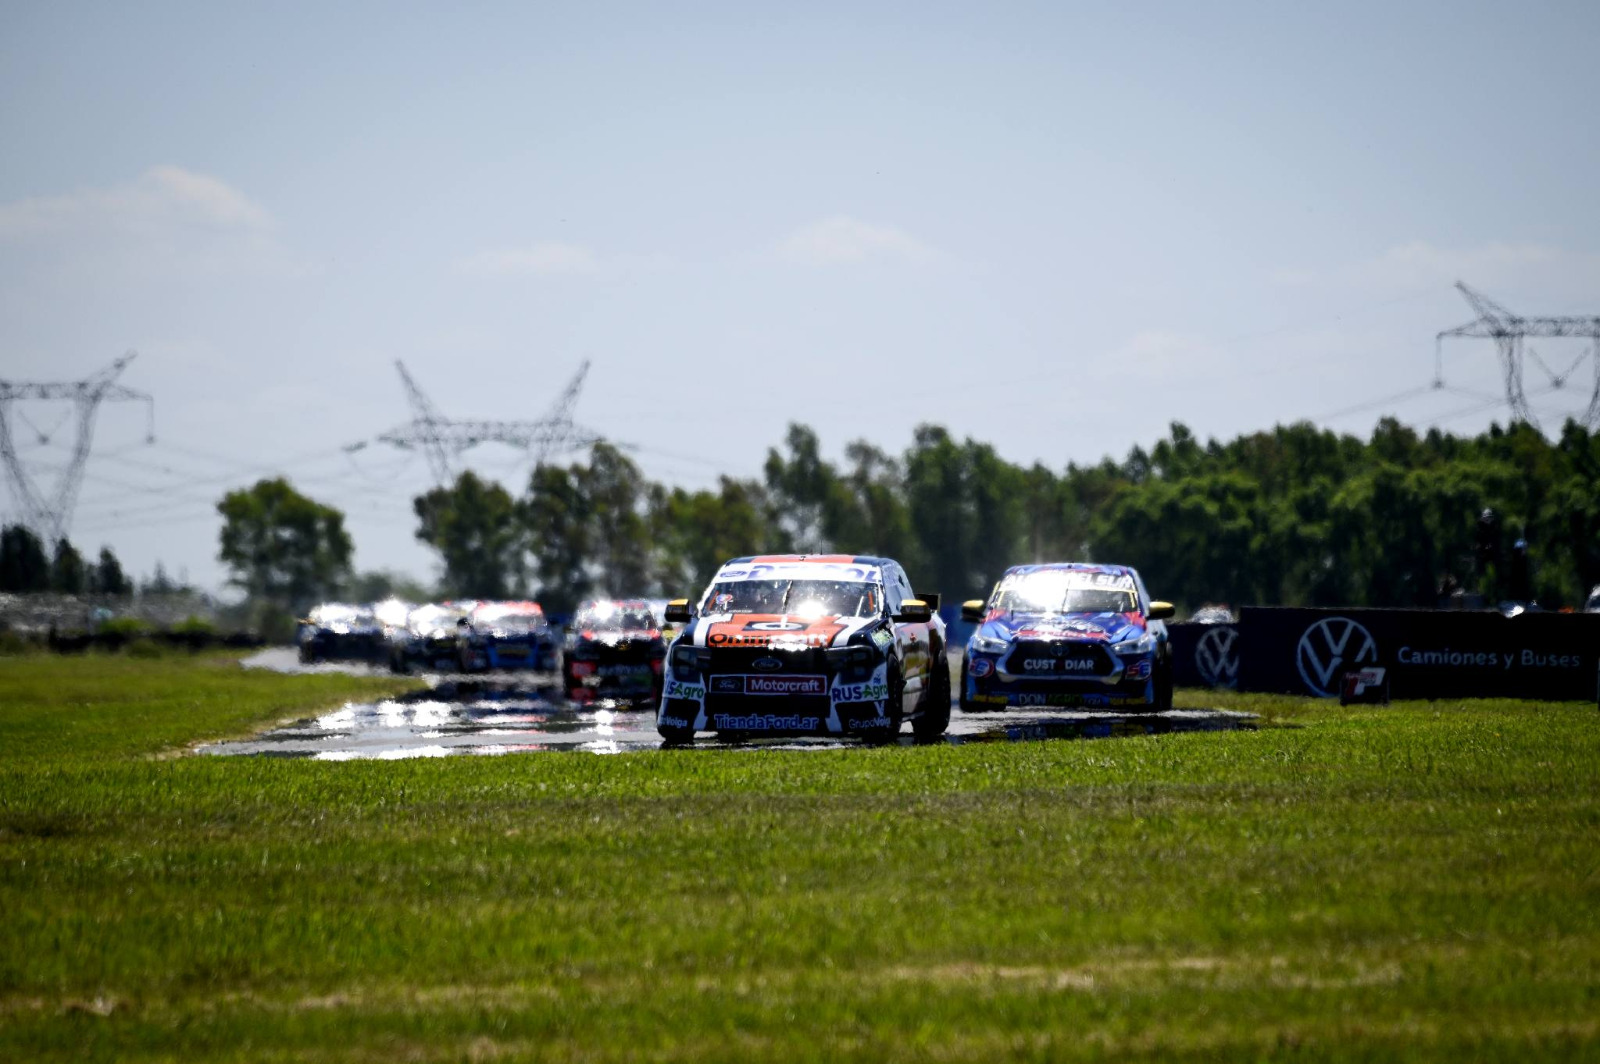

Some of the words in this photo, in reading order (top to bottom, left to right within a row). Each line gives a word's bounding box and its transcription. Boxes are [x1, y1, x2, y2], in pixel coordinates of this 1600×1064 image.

[1024, 659, 1094, 670] CUSTDIAR
[1398, 647, 1498, 666] Camiones
[1504, 651, 1515, 669] y
[1521, 648, 1581, 667] Buses
[751, 679, 819, 692] Motorcraft
[714, 713, 819, 730] TiendaFord.ar
